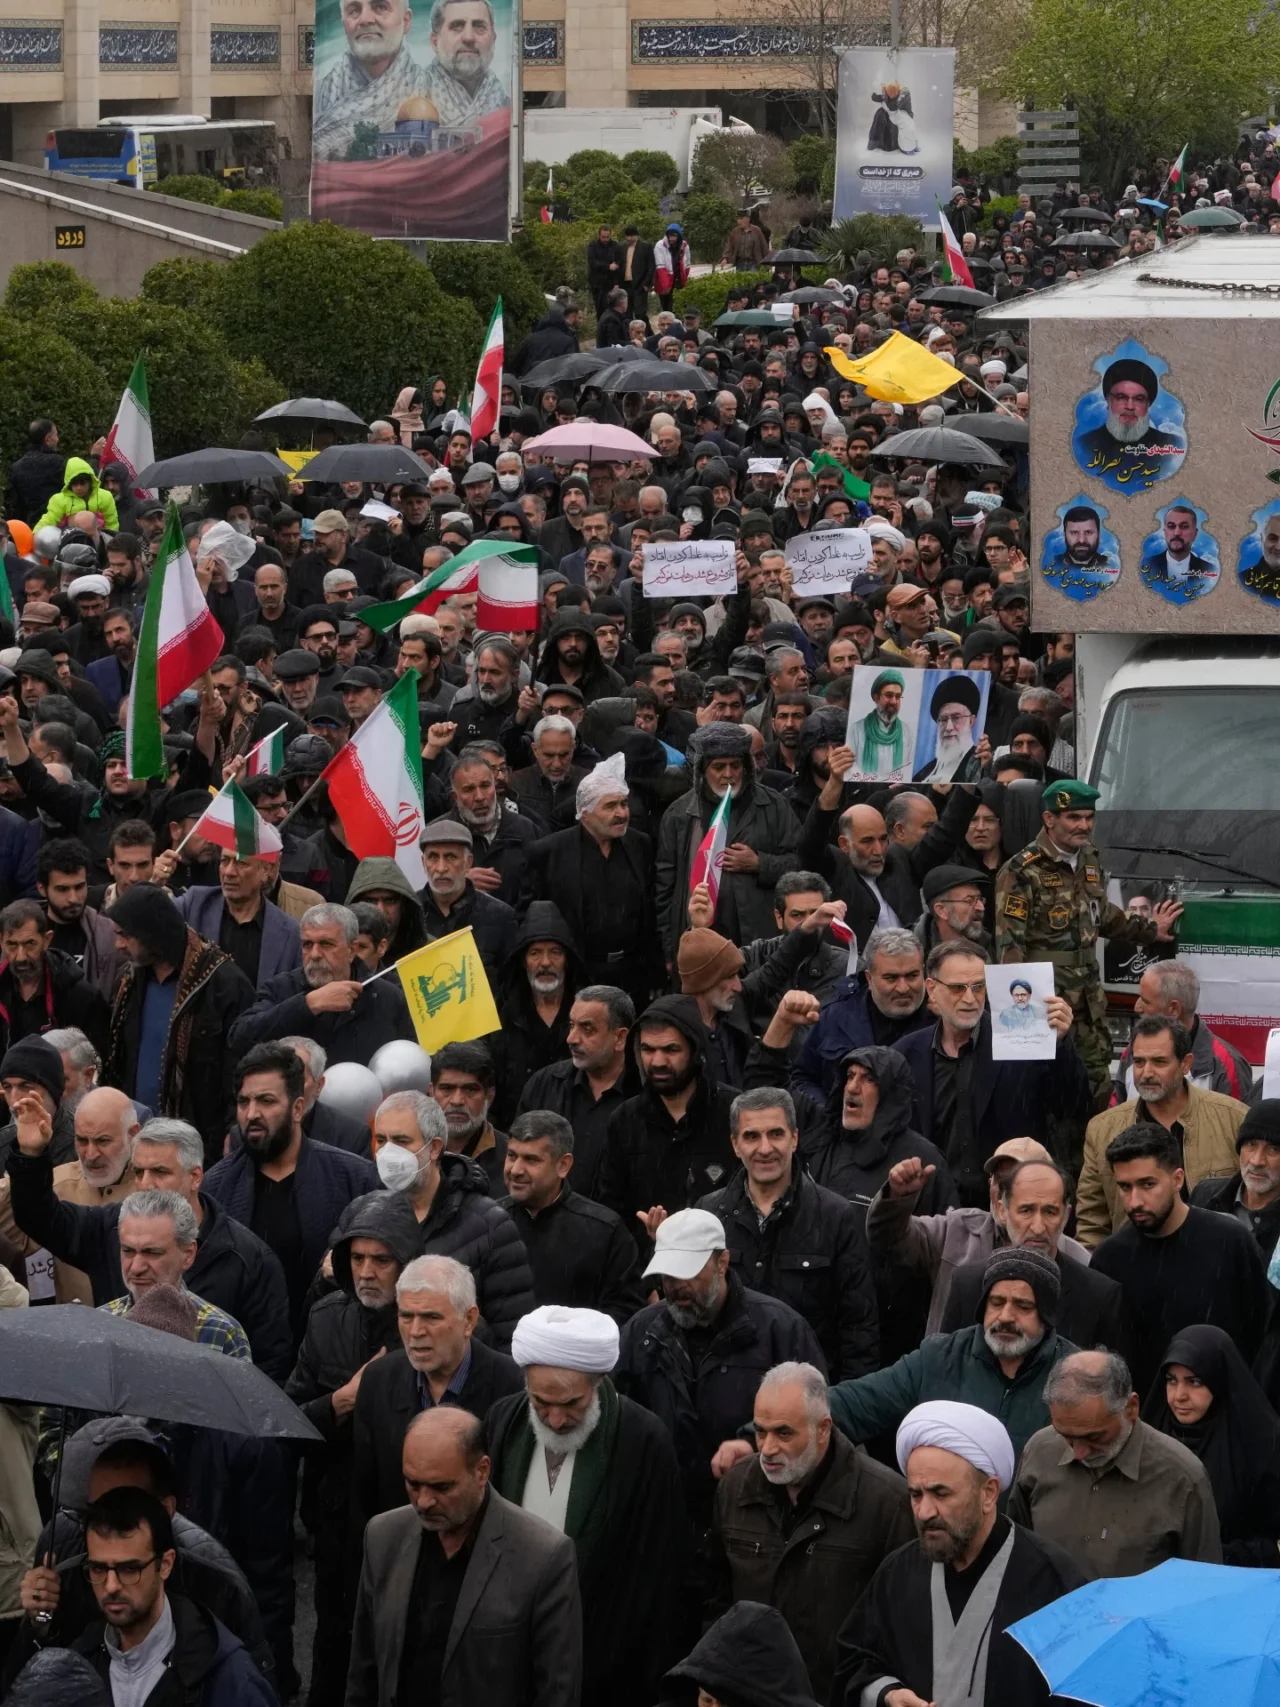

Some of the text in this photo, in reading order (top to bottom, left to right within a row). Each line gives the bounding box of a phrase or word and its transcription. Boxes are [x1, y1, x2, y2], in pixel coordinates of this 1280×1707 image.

[886, 168, 892, 178] از
[893, 168, 902, 176] که
[901, 170, 920, 178] صبری
[57, 231, 84, 246] ورود
[1124, 443, 1148, 456] مقاومت
[1117, 462, 1145, 482] حسن
[1140, 465, 1160, 486] سید
[650, 548, 667, 562] افتاد
[667, 545, 692, 564] کردن
[688, 546, 703, 560] غلط
[710, 545, 729, 563] ترامپ
[792, 549, 808, 564] افتاد
[808, 545, 831, 564] کردن
[829, 546, 842, 560] غلط
[848, 544, 867, 562] ترامپ
[1043, 562, 1068, 577] موسوی
[1060, 574, 1085, 588] مهدی
[1244, 567, 1269, 588] سلیمانی
[1260, 577, 1280, 593] قاسم
[1184, 583, 1205, 600] حسین
[28, 1260, 48, 1277] شد
